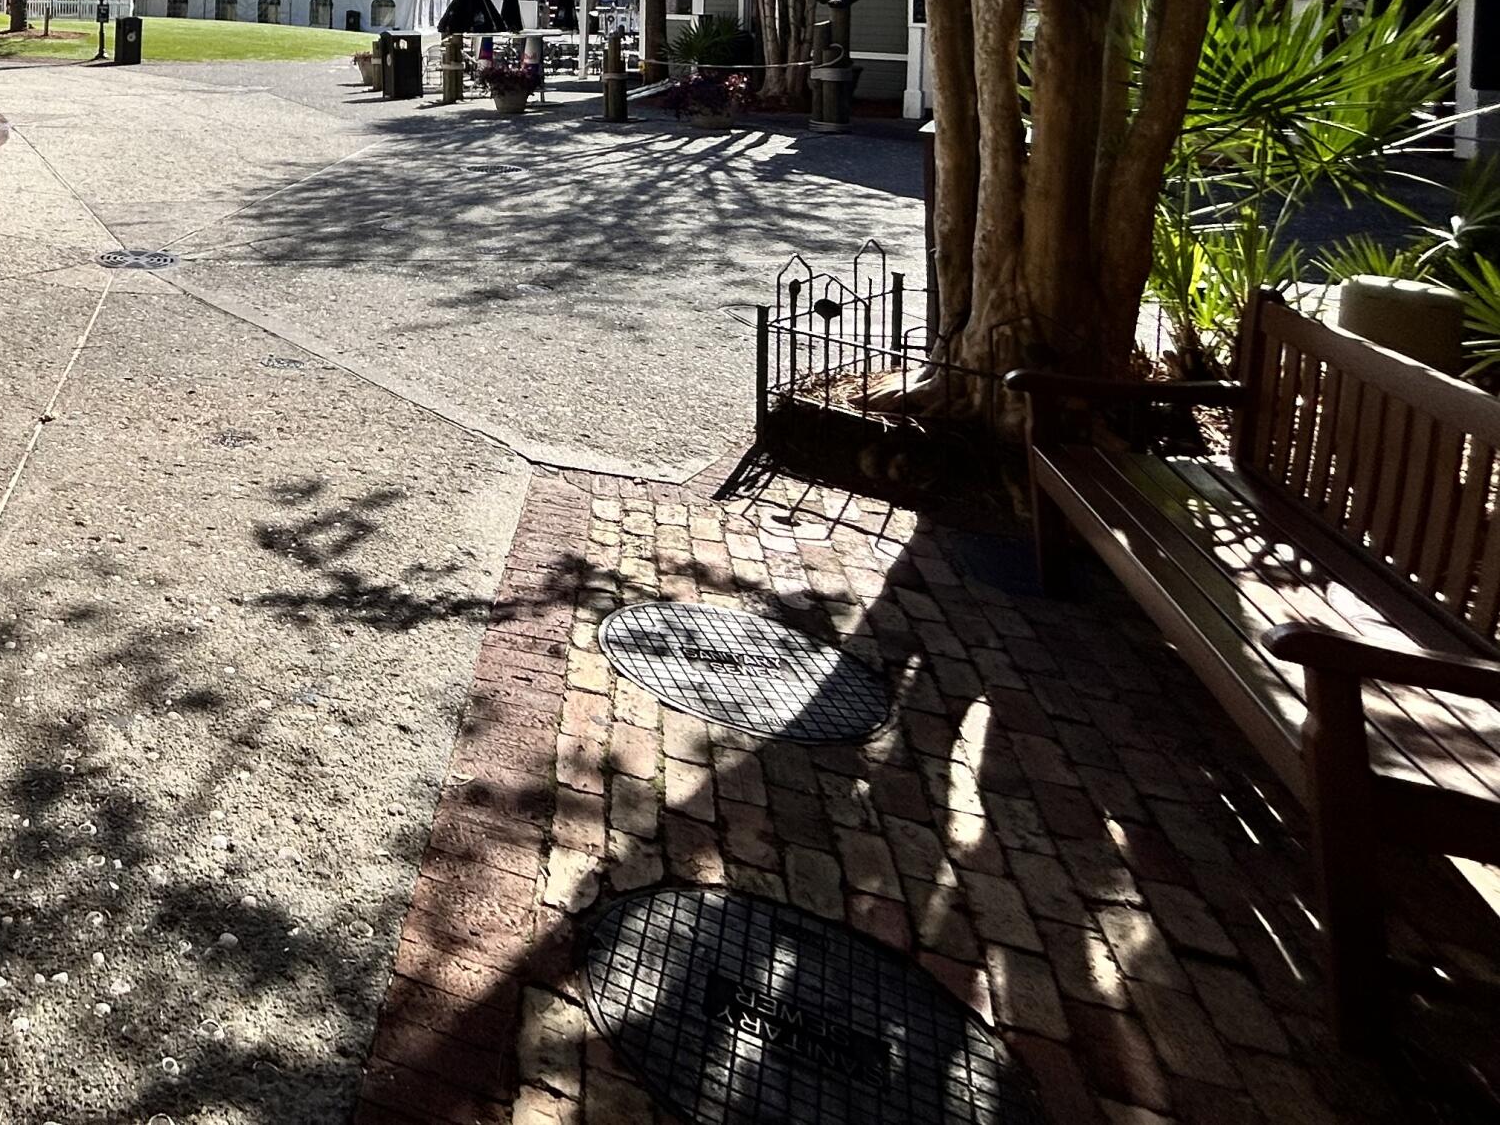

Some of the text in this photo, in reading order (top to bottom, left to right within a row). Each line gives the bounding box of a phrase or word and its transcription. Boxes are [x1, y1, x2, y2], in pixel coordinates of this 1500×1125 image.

[684, 648, 781, 668] SANITARY
[710, 662, 785, 680] SEWER
[735, 985, 850, 1047] SEWER
[717, 1004, 884, 1088] SANITARY
